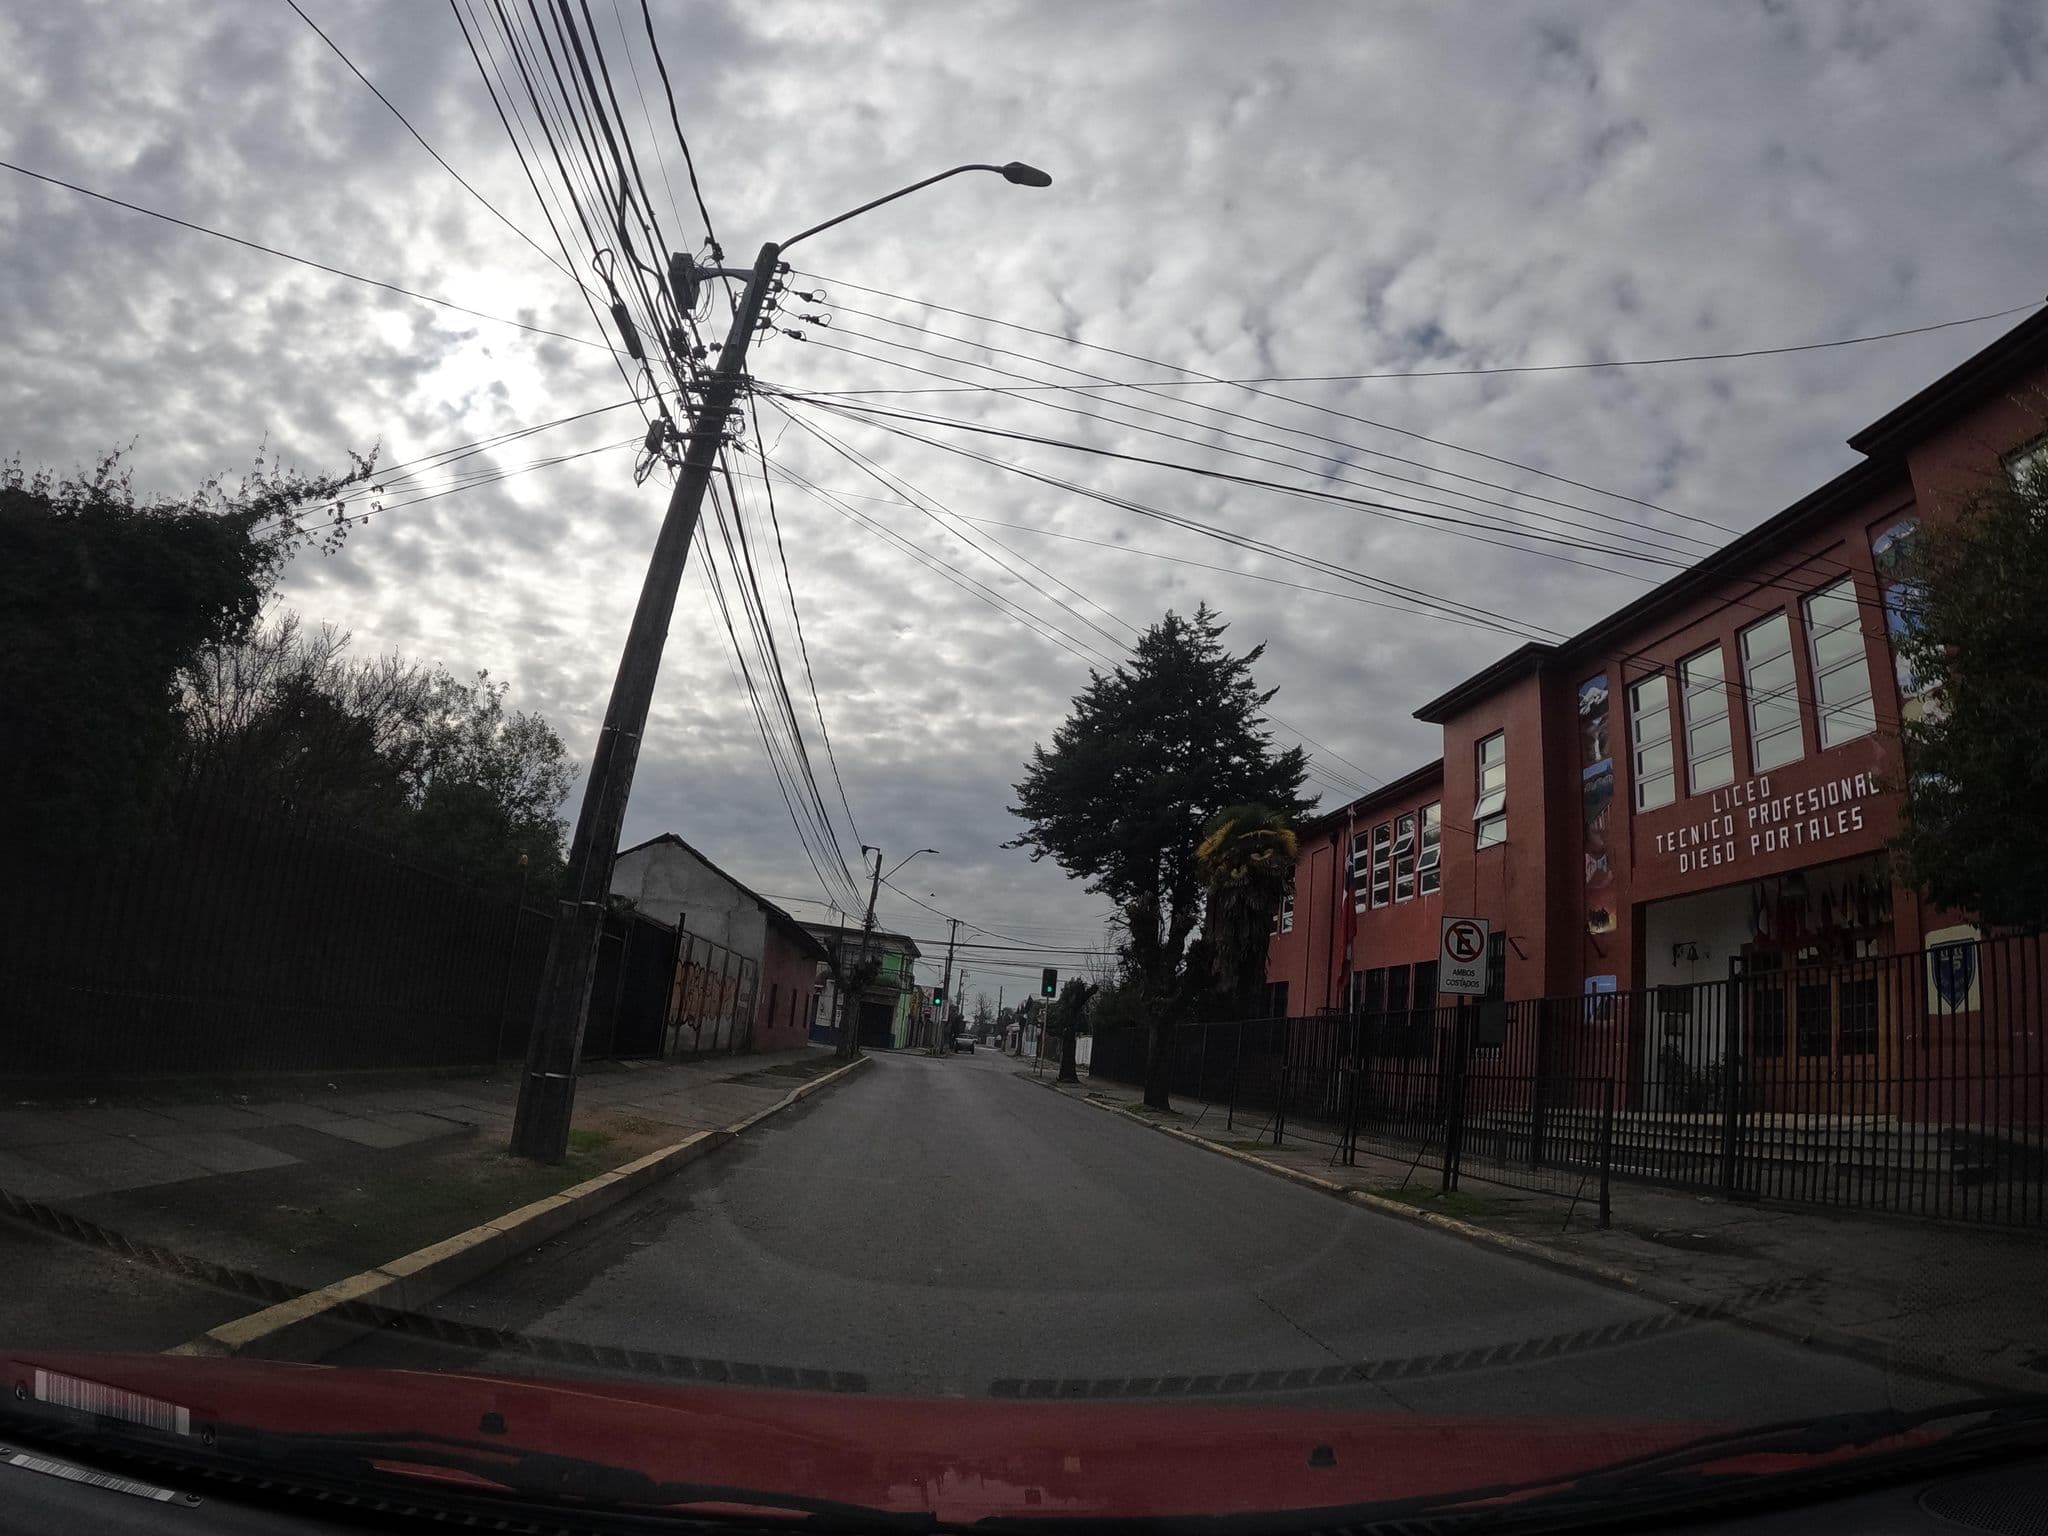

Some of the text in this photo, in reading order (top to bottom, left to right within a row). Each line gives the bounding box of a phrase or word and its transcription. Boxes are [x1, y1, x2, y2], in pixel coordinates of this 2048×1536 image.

[1656, 771, 1879, 853] TECNICO PROFESIONAL
[1713, 775, 1770, 813] LICEO
[1680, 806, 1862, 873] DIEGO PORTALES
[1452, 968, 1476, 977] AMBOS
